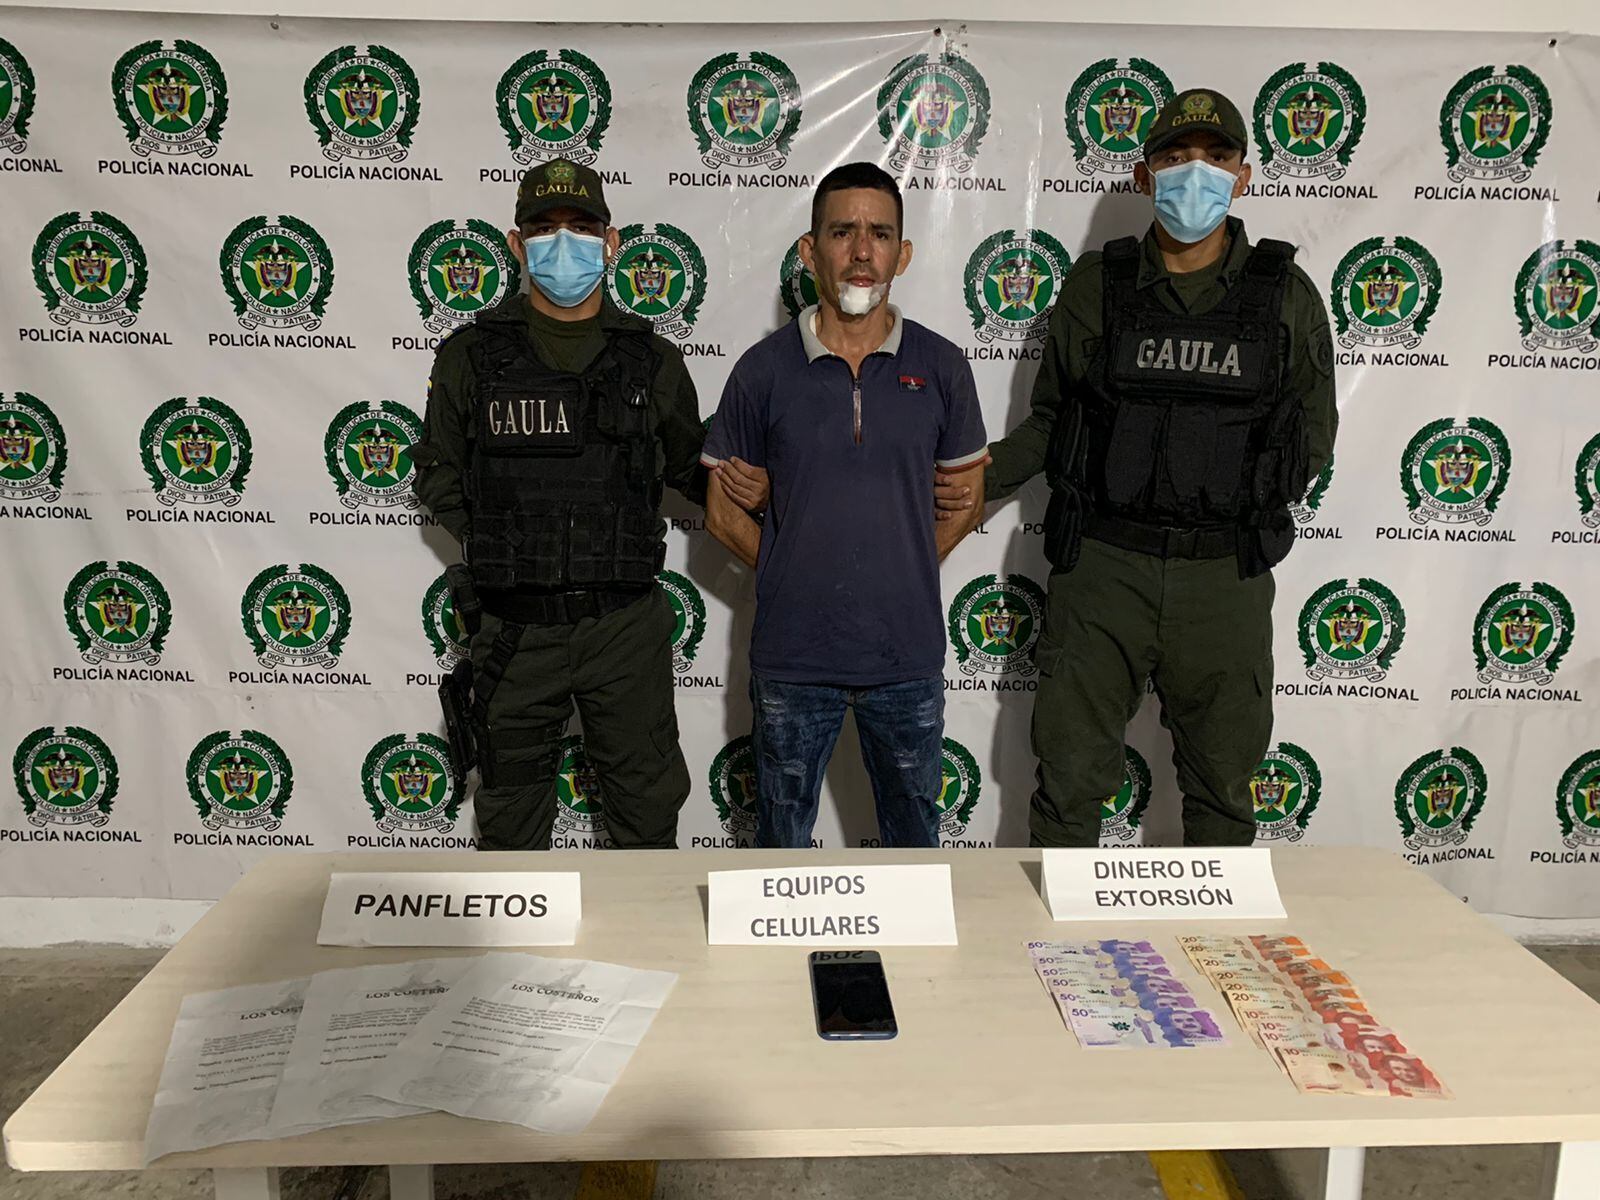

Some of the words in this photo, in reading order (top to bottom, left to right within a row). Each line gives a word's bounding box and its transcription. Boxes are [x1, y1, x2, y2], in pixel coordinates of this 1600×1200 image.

[126, 55, 154, 91] REPUBLICA
[182, 55, 212, 92] COLOMBIA
[319, 61, 347, 97] REPUBLICA
[375, 61, 404, 96] COLOMBIA
[1268, 79, 1298, 116] REPUBLICA
[1324, 78, 1351, 115] COLOMBIA
[136, 116, 165, 139] POLICIA
[175, 116, 211, 140] NACIONAL
[328, 121, 356, 144] POLICIA
[367, 121, 402, 144] NACIONAL
[140, 138, 159, 150] DIOS
[178, 140, 208, 151] PATRIA
[332, 143, 350, 155] DIOS
[369, 144, 398, 156] PATRIA
[1270, 140, 1299, 163] POLICIA
[1309, 139, 1343, 163] NACIONAL
[0, 159, 63, 173] CIONAL
[99, 159, 164, 174] POLICÍA
[168, 162, 253, 177] NACIONAL
[291, 163, 355, 179] POLICÍA
[360, 167, 443, 181] NACIONAL
[1272, 161, 1291, 174] DIOS
[1309, 163, 1337, 174] PATRIA
[669, 171, 731, 186] POLICÍA
[738, 175, 819, 188] NACIONAL
[1043, 178, 1106, 194] POLICÍA
[536, 184, 589, 198] GAULA
[1242, 181, 1291, 197] OLICÍA
[1296, 185, 1377, 198] NACIONAL
[1415, 182, 1476, 199] POLICÍA
[1481, 187, 1559, 201] NACIONAL
[46, 228, 74, 263] REPUBLICA
[102, 228, 131, 263] COLOMBIA
[234, 232, 261, 267] REPUBLICA
[288, 232, 317, 267] COLOMBIA
[56, 287, 85, 309] POLICIA
[96, 287, 131, 310] NACIONAL
[243, 291, 271, 313] POLICIA
[281, 291, 316, 314] NACIONAL
[61, 308, 80, 320] DIOS
[98, 310, 127, 321] PATRIA
[247, 312, 266, 324] DIOS
[284, 314, 313, 325] PATRIA
[19, 327, 84, 342] POLICÍA
[89, 331, 172, 345] NACIONAL
[209, 332, 270, 347] POLICÍA
[275, 335, 356, 348] NACIONAL
[1136, 338, 1242, 377] GAULA
[1336, 350, 1366, 365] ICÍA
[1372, 353, 1448, 366] NACIONAL
[1488, 353, 1546, 368] POLICÍA
[1551, 357, 1600, 370] NACIO
[488, 399, 571, 436] GAULA
[154, 413, 181, 446] REPUBLICA
[208, 412, 237, 446] COLOMBIA
[163, 469, 191, 490] POLICIA
[201, 468, 235, 490] NACIONAL
[167, 489, 185, 500] DIOS
[203, 490, 232, 501] PATRIA
[13, 507, 92, 520] NACIONAL
[127, 508, 189, 522] POLICÍA
[194, 511, 275, 523] NACIONAL
[310, 510, 371, 525] POLICÍA
[376, 513, 438, 526] NACION
[1420, 508, 1438, 519] DIOS
[1457, 510, 1486, 520] PATRIA
[1294, 527, 1342, 540] CIONAL
[1376, 524, 1440, 540] POLICÍA
[1445, 530, 1516, 542] NACIONAL
[54, 666, 113, 680] POLICÍA
[117, 669, 194, 682] NACIONAL
[229, 668, 289, 683] POLICÍA
[294, 672, 371, 685] NACIONAL
[673, 676, 723, 688] CIONAL
[943, 676, 987, 691] OLICÍA
[992, 680, 1038, 692] NACIO
[1276, 680, 1332, 695] POLICÍA
[1337, 685, 1419, 701] NACIONAL
[1451, 685, 1501, 700] POLICÍA
[1506, 689, 1582, 701] NACIONAL
[1, 826, 60, 841] POLICÍA
[64, 831, 142, 842] NACIONAL
[174, 830, 232, 845] POLICÍA
[237, 835, 314, 846] NACIONAL
[348, 834, 406, 847] POLICÍA
[410, 836, 477, 848] NACIONA
[550, 834, 578, 848] ICÍA
[692, 834, 749, 848] POLICÍA
[1432, 846, 1495, 863] NACIONAL
[1531, 848, 1586, 863] POLICÍA
[1094, 860, 1185, 880] DINERO
[1191, 860, 1224, 878] DE
[763, 875, 865, 899] EQUIPOS
[1095, 885, 1234, 907] EXTORSIÓN
[354, 894, 547, 917] PANFLETOS
[751, 916, 879, 937] CELULARES
[1028, 941, 1043, 949] 50
[1043, 968, 1058, 976] 50
[1217, 972, 1233, 980] 20
[511, 983, 535, 993] LOS
[1053, 979, 1068, 987] 50
[1226, 983, 1242, 991] 20
[1060, 993, 1076, 1001] 50
[1232, 993, 1249, 1001] 20
[1072, 1008, 1089, 1017] 50
[1244, 1010, 1259, 1019] 10
[1261, 1022, 1276, 1031] 10
[1264, 1032, 1279, 1041] 10
[1284, 1048, 1300, 1056] 10
